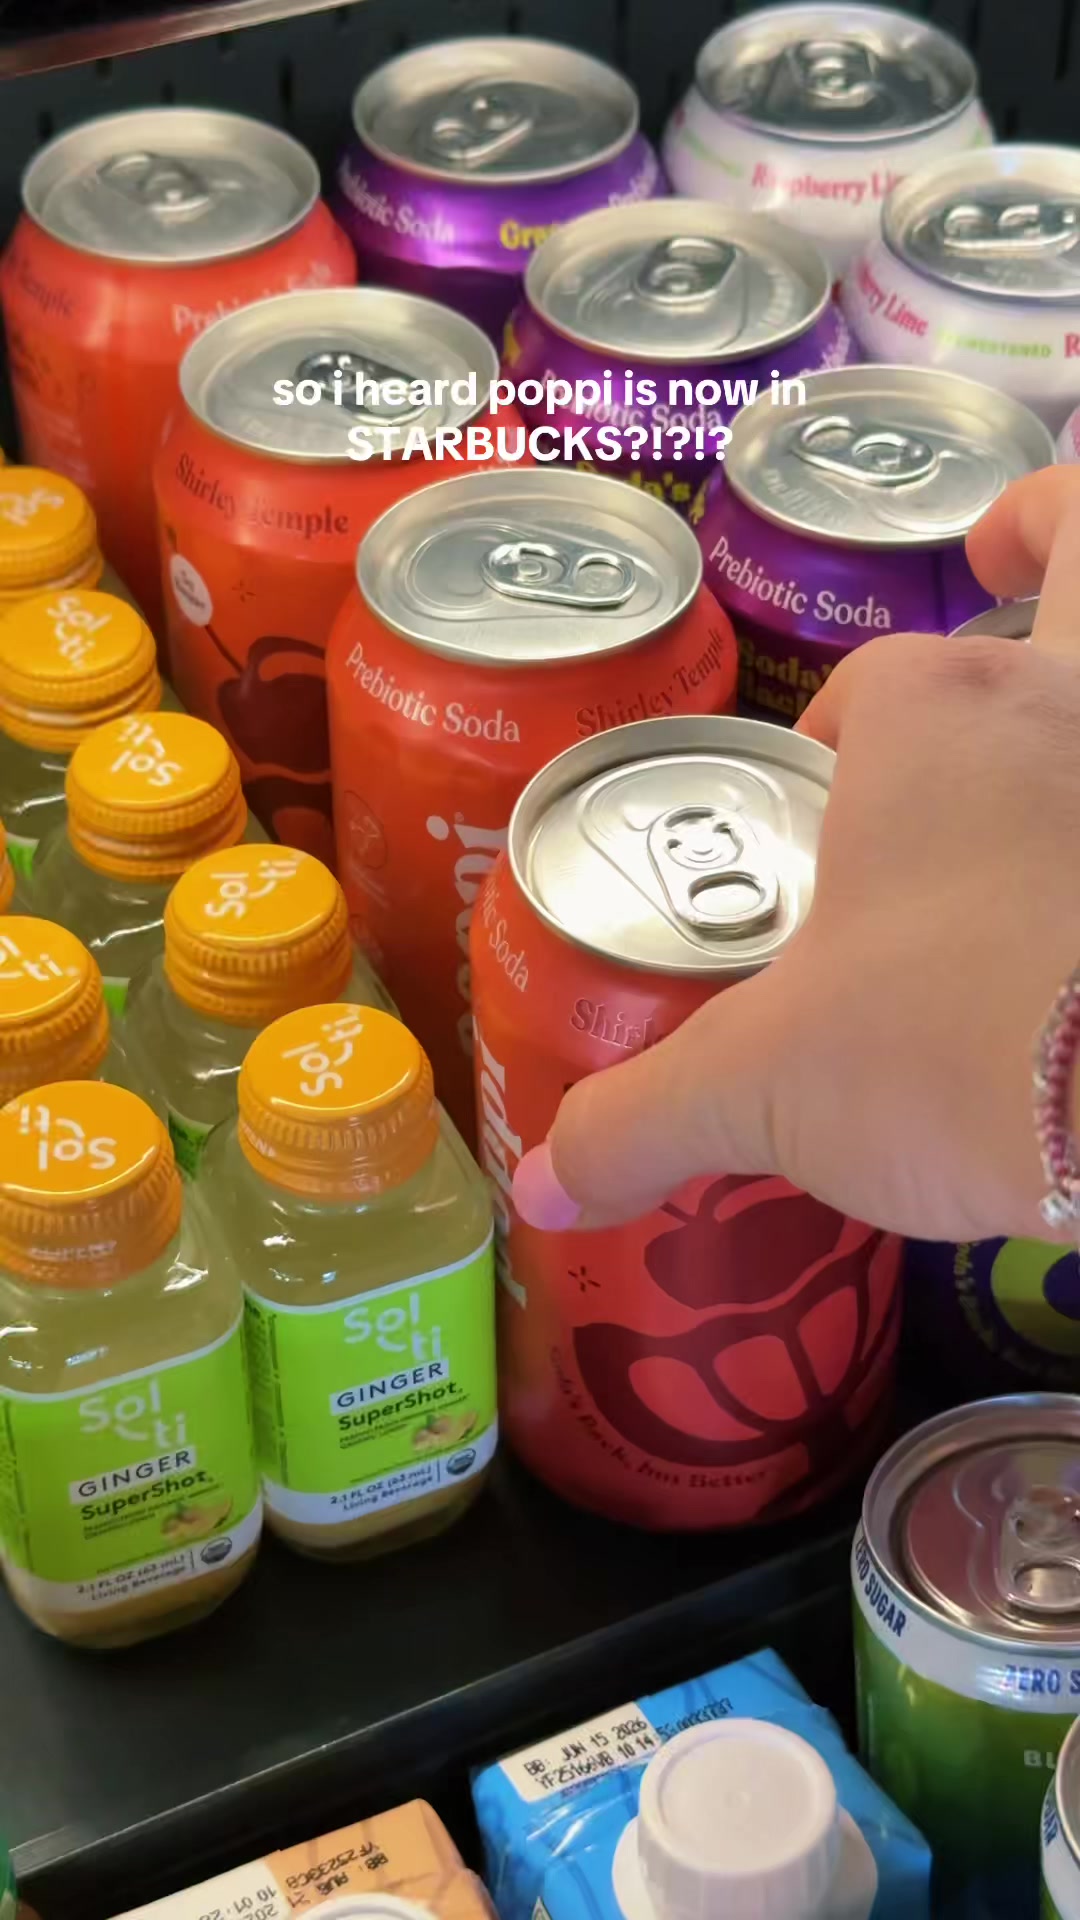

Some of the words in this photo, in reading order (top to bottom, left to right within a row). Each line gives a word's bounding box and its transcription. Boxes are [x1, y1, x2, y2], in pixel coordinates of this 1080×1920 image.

[500, 219, 566, 250] Gra
[175, 452, 236, 520] Shirley
[708, 535, 808, 614] Prebiotic
[813, 590, 892, 629] Soda
[344, 641, 436, 727] Prebiotic
[441, 702, 521, 744] Soda
[574, 687, 673, 738] Shirley
[204, 872, 249, 919] Sol
[488, 919, 529, 993] Soda
[569, 997, 664, 1051] Shirl
[281, 1041, 343, 1097] Sol
[37, 1137, 118, 1172] Sol
[343, 1291, 421, 1345] Sol
[79, 1377, 161, 1434] Sol
[336, 1362, 445, 1409] GINGER
[77, 1450, 192, 1498] GINGER
[864, 1573, 908, 1638] SUGAR
[1004, 1664, 1061, 1696] ZERO
[561, 1738, 586, 1762] JUN
[590, 1730, 610, 1749] 15
[611, 1715, 649, 1739] 2026
[1023, 1750, 1056, 1770] BL
